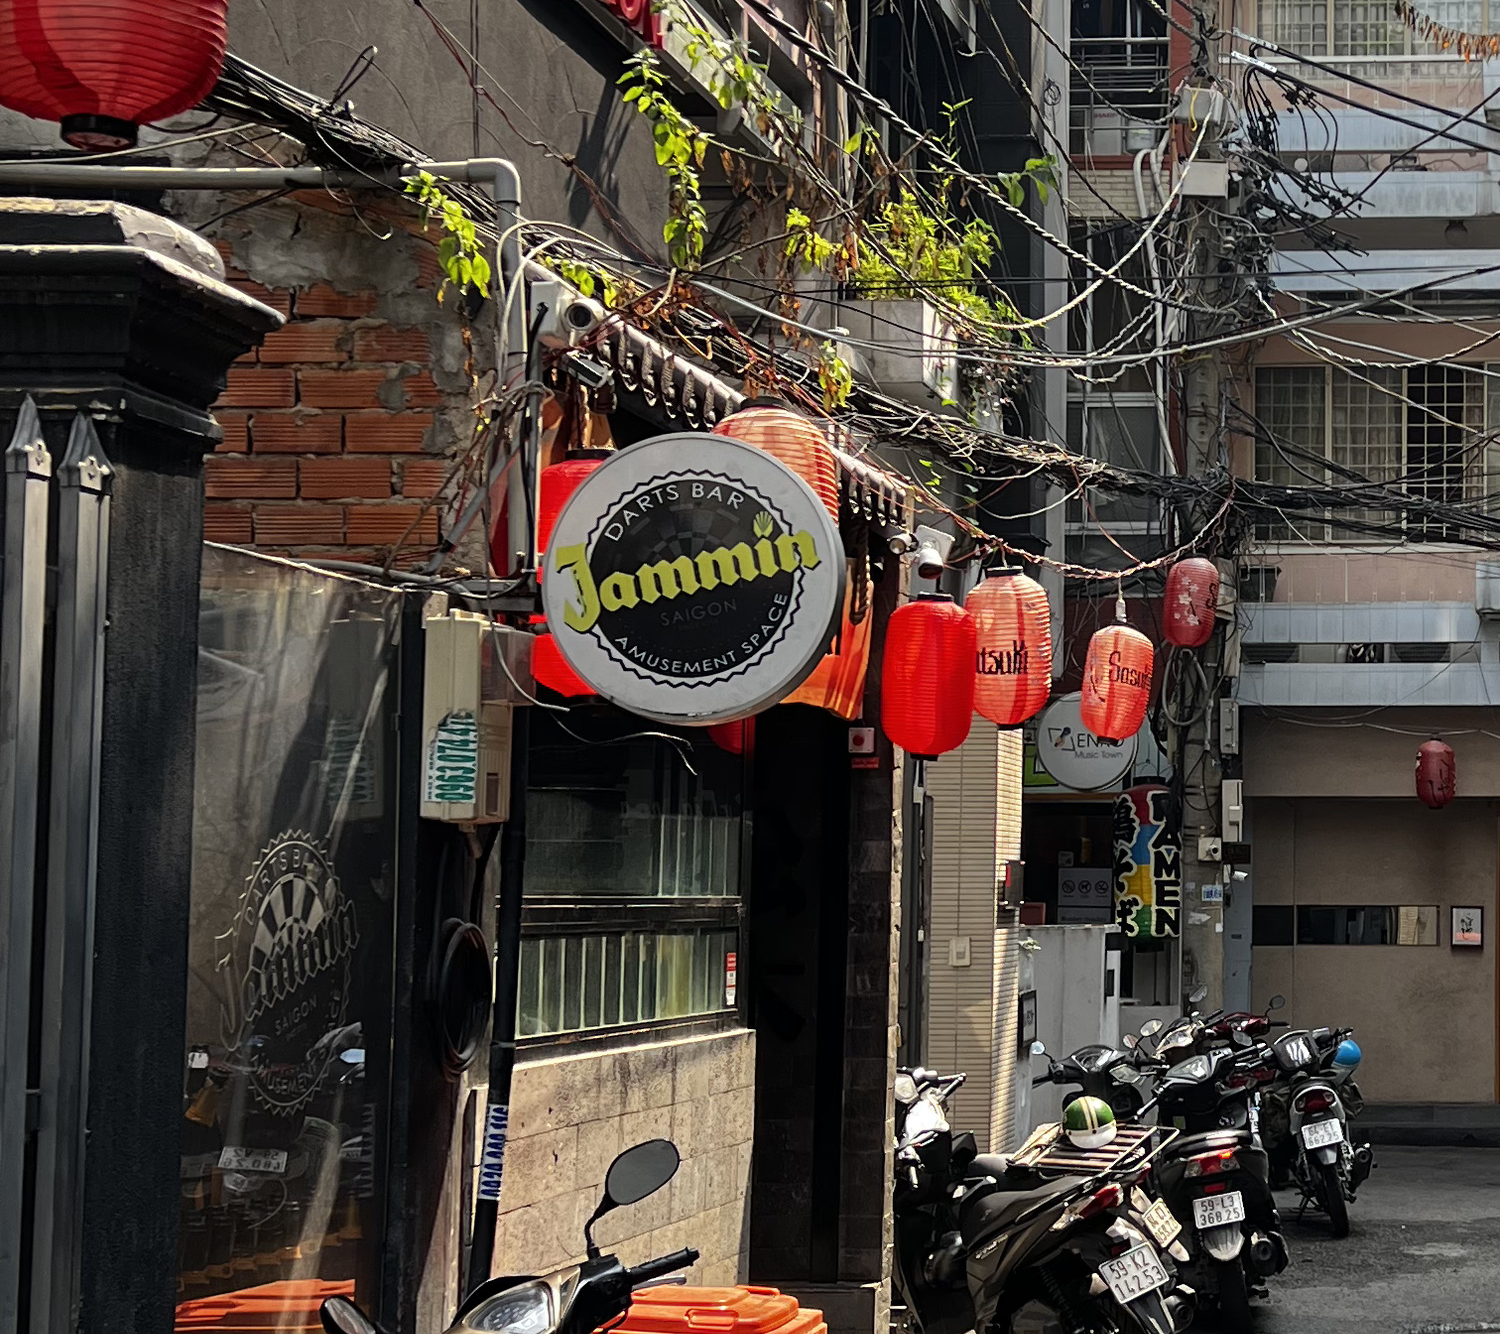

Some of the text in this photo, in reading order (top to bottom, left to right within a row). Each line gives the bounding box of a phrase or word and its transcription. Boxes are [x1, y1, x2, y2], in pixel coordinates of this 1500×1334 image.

[604, 483, 746, 542] DARTS BAR
[555, 511, 822, 634] Jammin
[660, 598, 738, 627] SAIGON
[614, 636, 737, 674] AMUSEMENT
[741, 593, 789, 655] SPACE
[1074, 751, 1123, 759] Music Town
[275, 994, 318, 1035] SAIGON
[1201, 1196, 1235, 1212] 59-L3
[1109, 1250, 1150, 1280] 59-K2
[1114, 1265, 1164, 1299] 142.53
